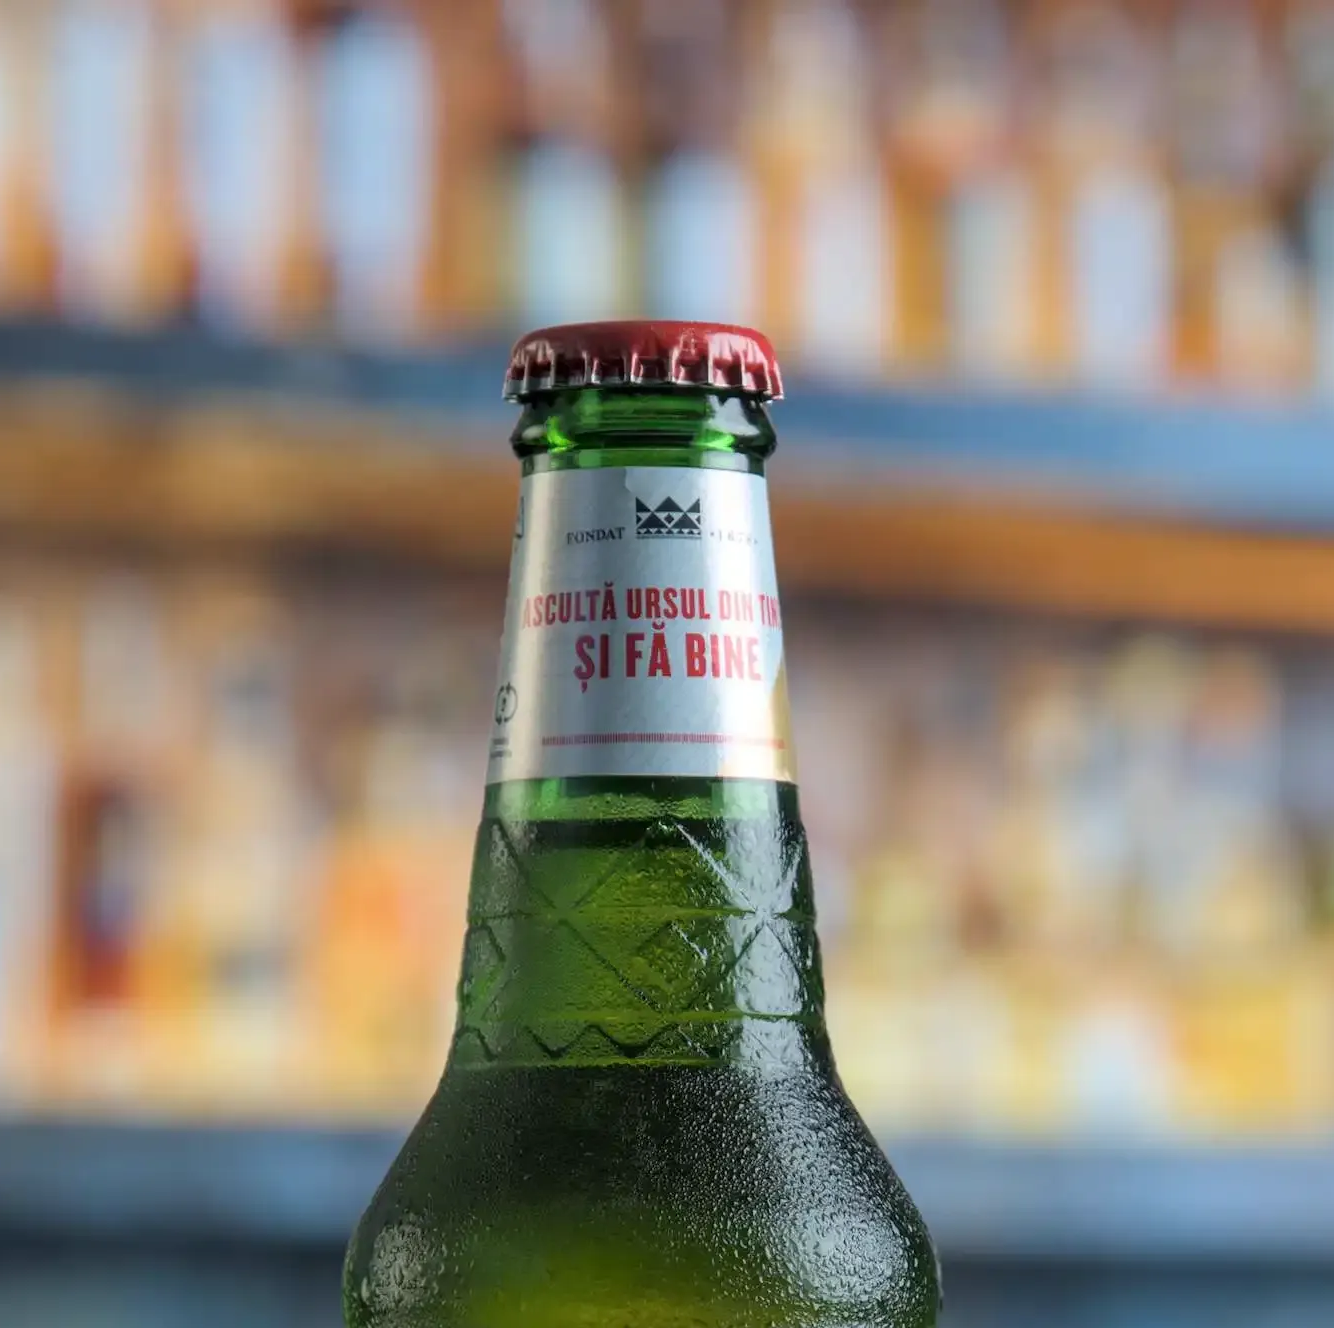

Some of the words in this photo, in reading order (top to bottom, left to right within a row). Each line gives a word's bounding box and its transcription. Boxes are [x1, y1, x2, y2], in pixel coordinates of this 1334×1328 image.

[567, 527, 625, 546] FONDAT
[522, 580, 616, 629] ASCULTĂ
[626, 587, 711, 620] URSUL
[718, 590, 753, 623] DIN
[574, 632, 609, 693] ȘI
[625, 620, 672, 678] FĂ
[685, 632, 762, 681] BINE
